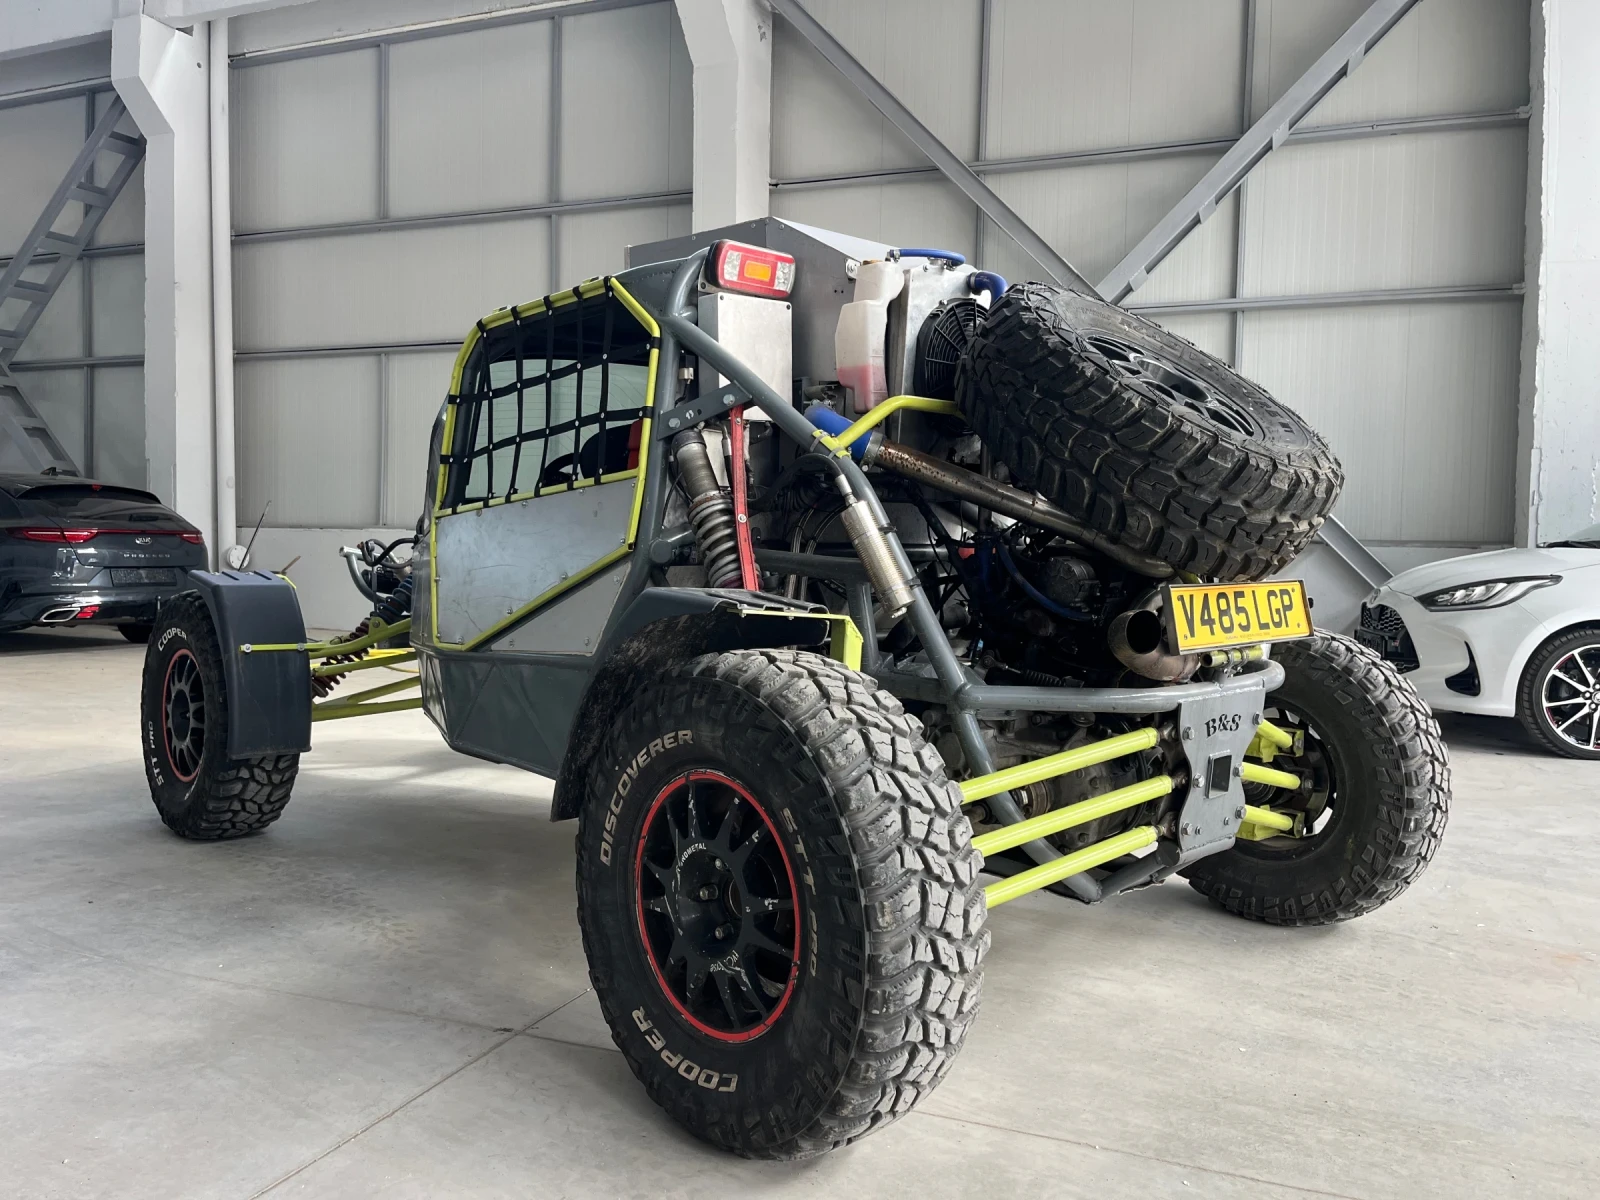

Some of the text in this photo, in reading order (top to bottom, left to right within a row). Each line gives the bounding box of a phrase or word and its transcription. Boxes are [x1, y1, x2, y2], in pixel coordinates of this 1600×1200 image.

[157, 627, 188, 651] COOPER
[1178, 588, 1294, 638] V485 LGP
[148, 720, 165, 787] STT PRO
[1204, 713, 1242, 740] B&S
[600, 729, 693, 867] DISCOVERER
[779, 807, 818, 977] STT PRO
[633, 1005, 738, 1093] COOPER
